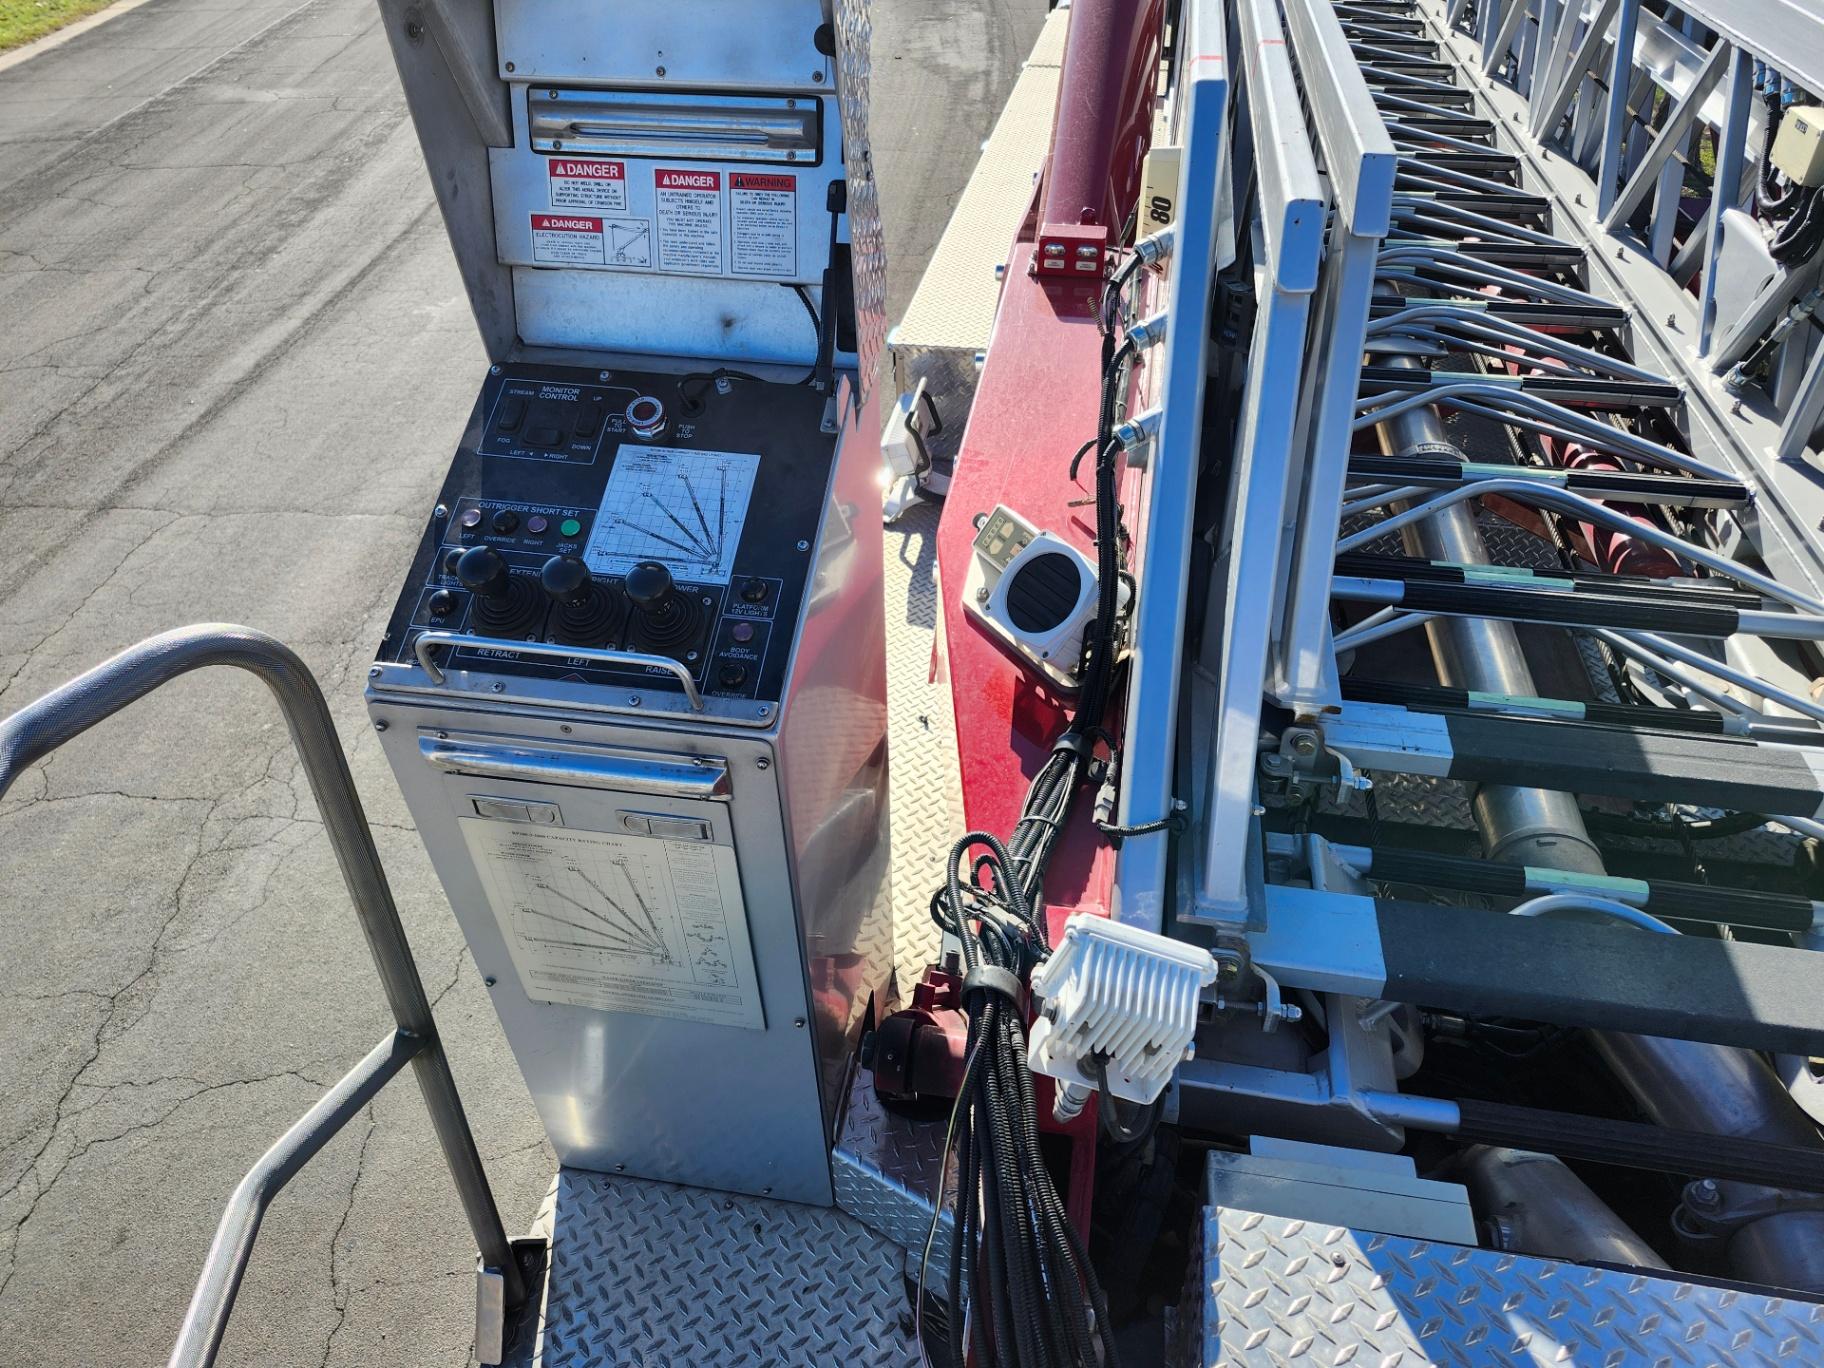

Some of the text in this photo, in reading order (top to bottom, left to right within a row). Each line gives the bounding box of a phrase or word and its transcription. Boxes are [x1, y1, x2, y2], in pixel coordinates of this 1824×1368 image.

[567, 163, 618, 177] DANGER
[671, 174, 714, 188] DANGER
[745, 177, 792, 188] WARNING
[1151, 195, 1172, 225] 80
[551, 219, 593, 230] DANGER
[536, 232, 577, 240] ELECTROCUTION
[509, 388, 535, 396] STREAM
[541, 386, 580, 395] MONITOR
[538, 392, 579, 402] CONTROL
[571, 443, 592, 451] DOWN
[478, 501, 580, 518] OUTRIGGER SHORT SET
[484, 535, 517, 545] OVERRIDE
[732, 603, 769, 612] PLATFORM
[743, 609, 769, 617] LIGHTS
[477, 648, 520, 660] RETRACT
[719, 652, 759, 662] AVOIDANCE
[567, 657, 590, 667] LEFT
[645, 666, 673, 675] RAISE
